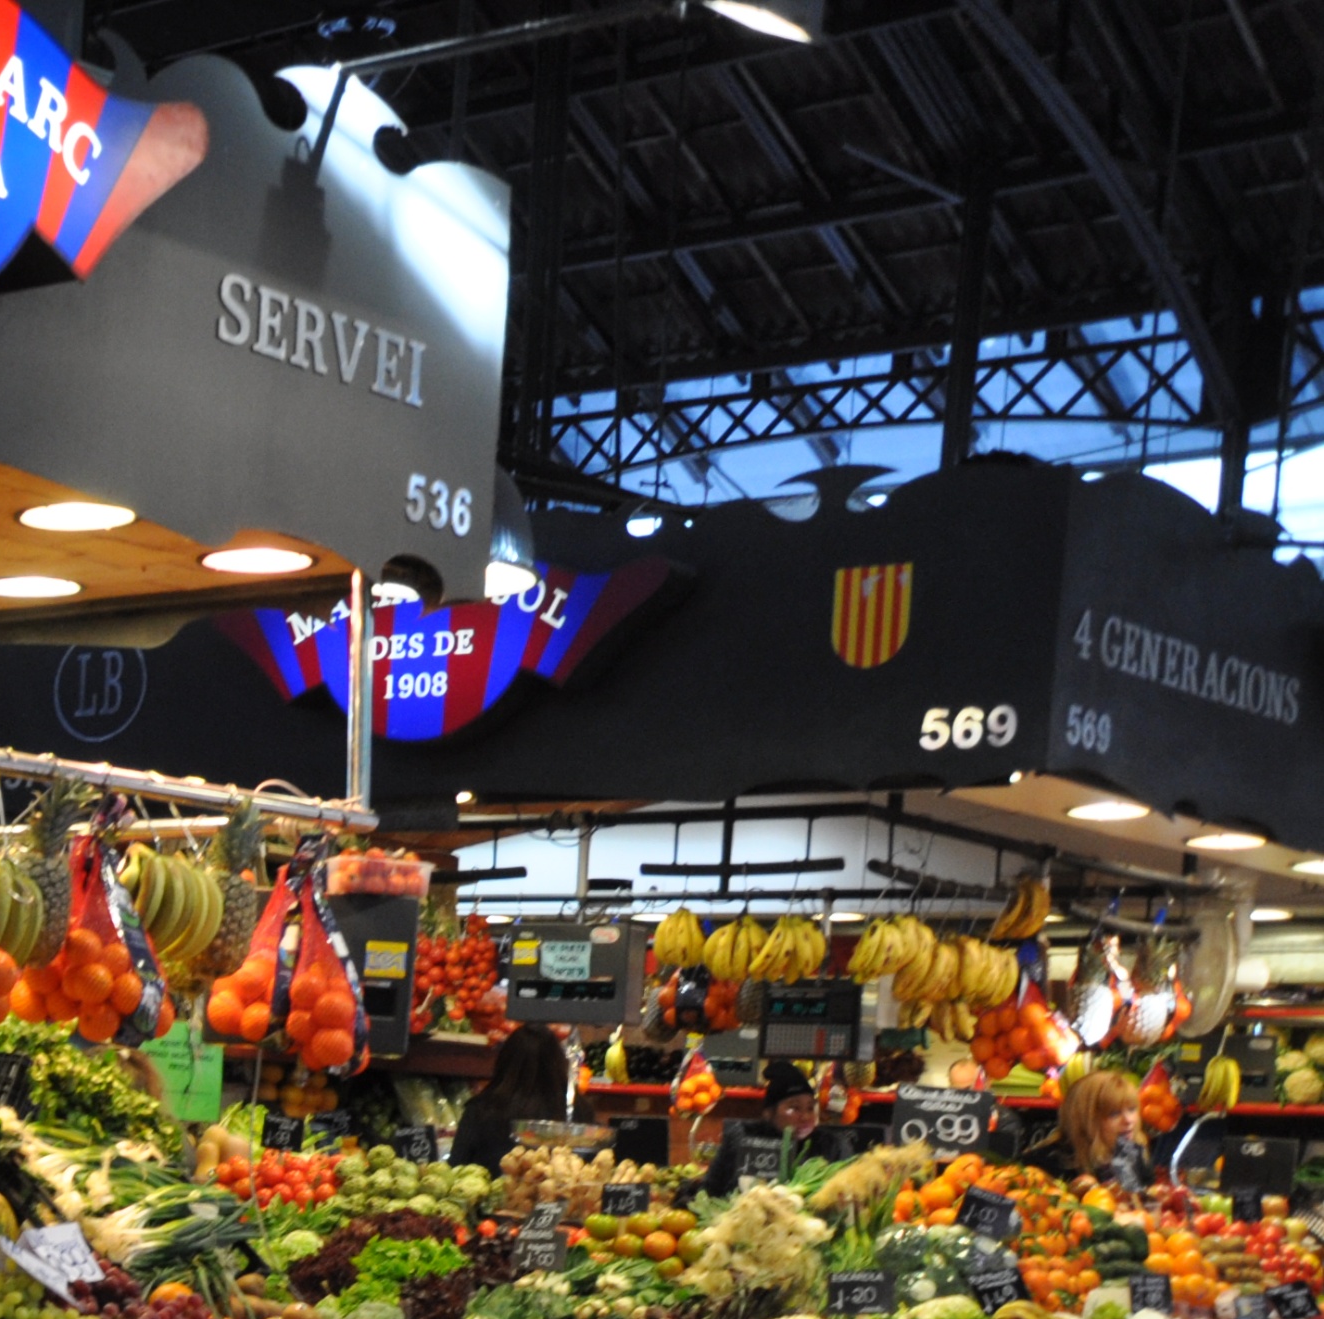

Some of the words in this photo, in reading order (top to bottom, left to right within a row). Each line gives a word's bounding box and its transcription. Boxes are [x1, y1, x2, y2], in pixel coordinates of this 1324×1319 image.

[215, 272, 428, 409] SERVEI
[403, 472, 473, 538] 536
[432, 629, 474, 657] DE
[1073, 608, 1093, 661] 4
[1100, 614, 1301, 726] GENERACIONS
[383, 671, 449, 700] 1908
[918, 703, 1019, 752] 569
[1065, 703, 1112, 755] 569
